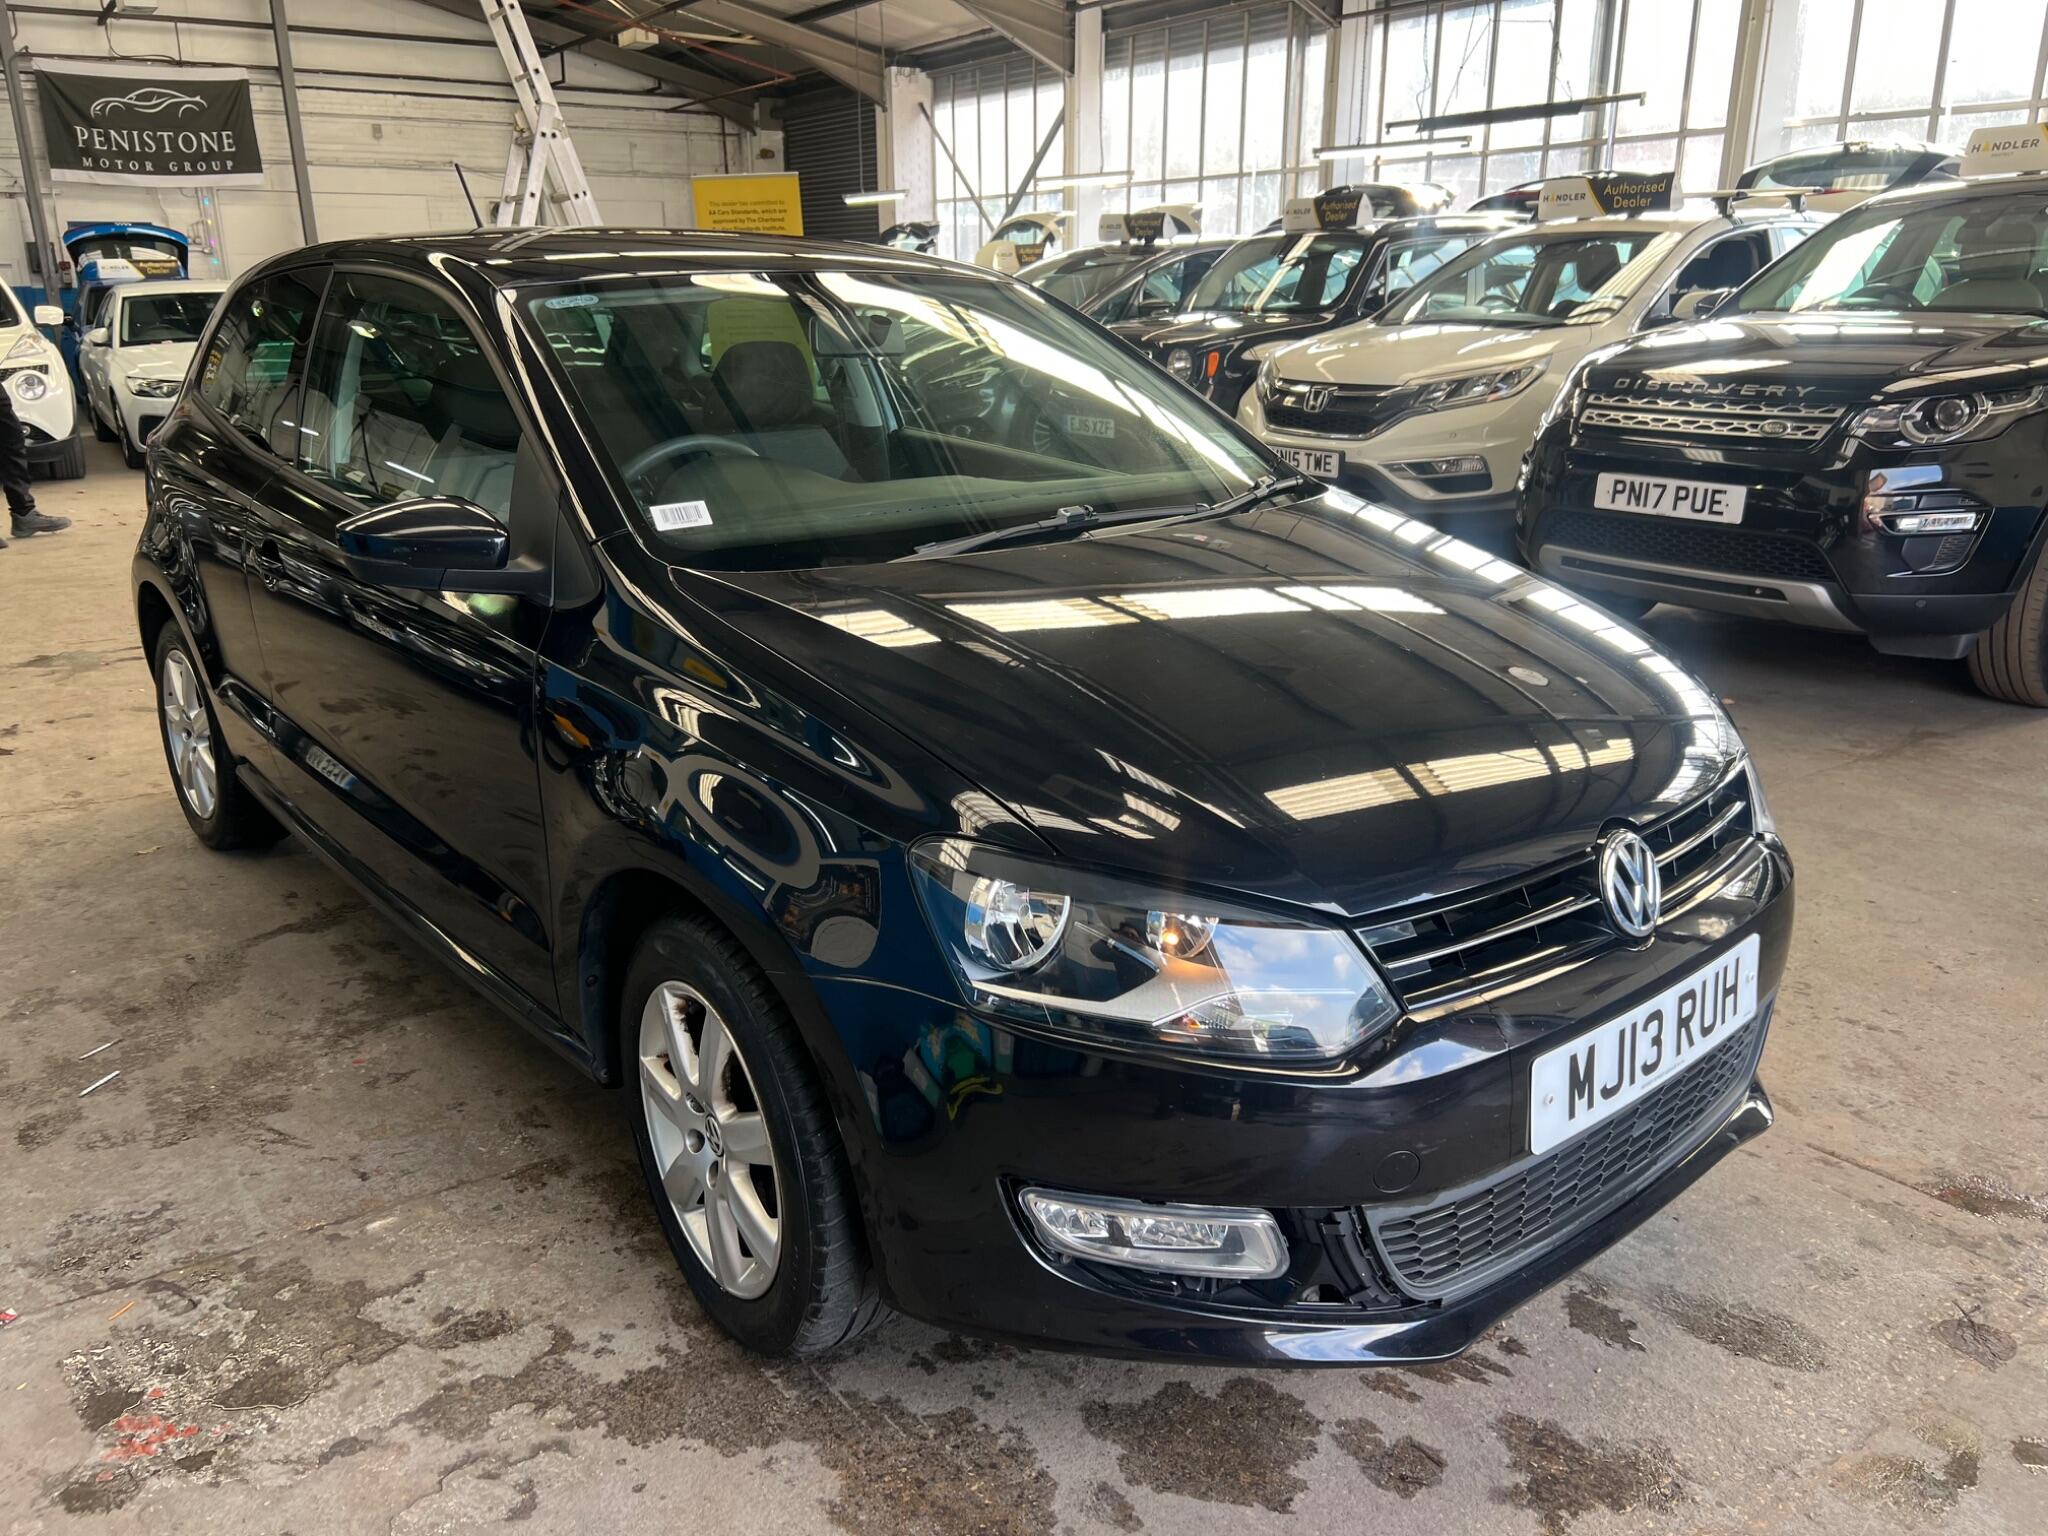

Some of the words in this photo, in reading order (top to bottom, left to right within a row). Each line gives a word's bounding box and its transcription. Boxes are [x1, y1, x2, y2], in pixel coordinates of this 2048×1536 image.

[74, 125, 236, 154] PENISTONE
[82, 157, 154, 171] MOTOR
[169, 160, 235, 172] GROUP
[1604, 179, 1666, 195] Authorised
[1613, 196, 1652, 209] Dealer
[1614, 378, 1817, 398] DISCOVERY
[1272, 449, 1300, 468] N15
[1304, 452, 1333, 473] TWE
[1610, 479, 1668, 509] PN17
[1672, 485, 1728, 516] PUE
[1568, 1008, 1664, 1121] MJ13
[1676, 956, 1741, 1057] RUH
